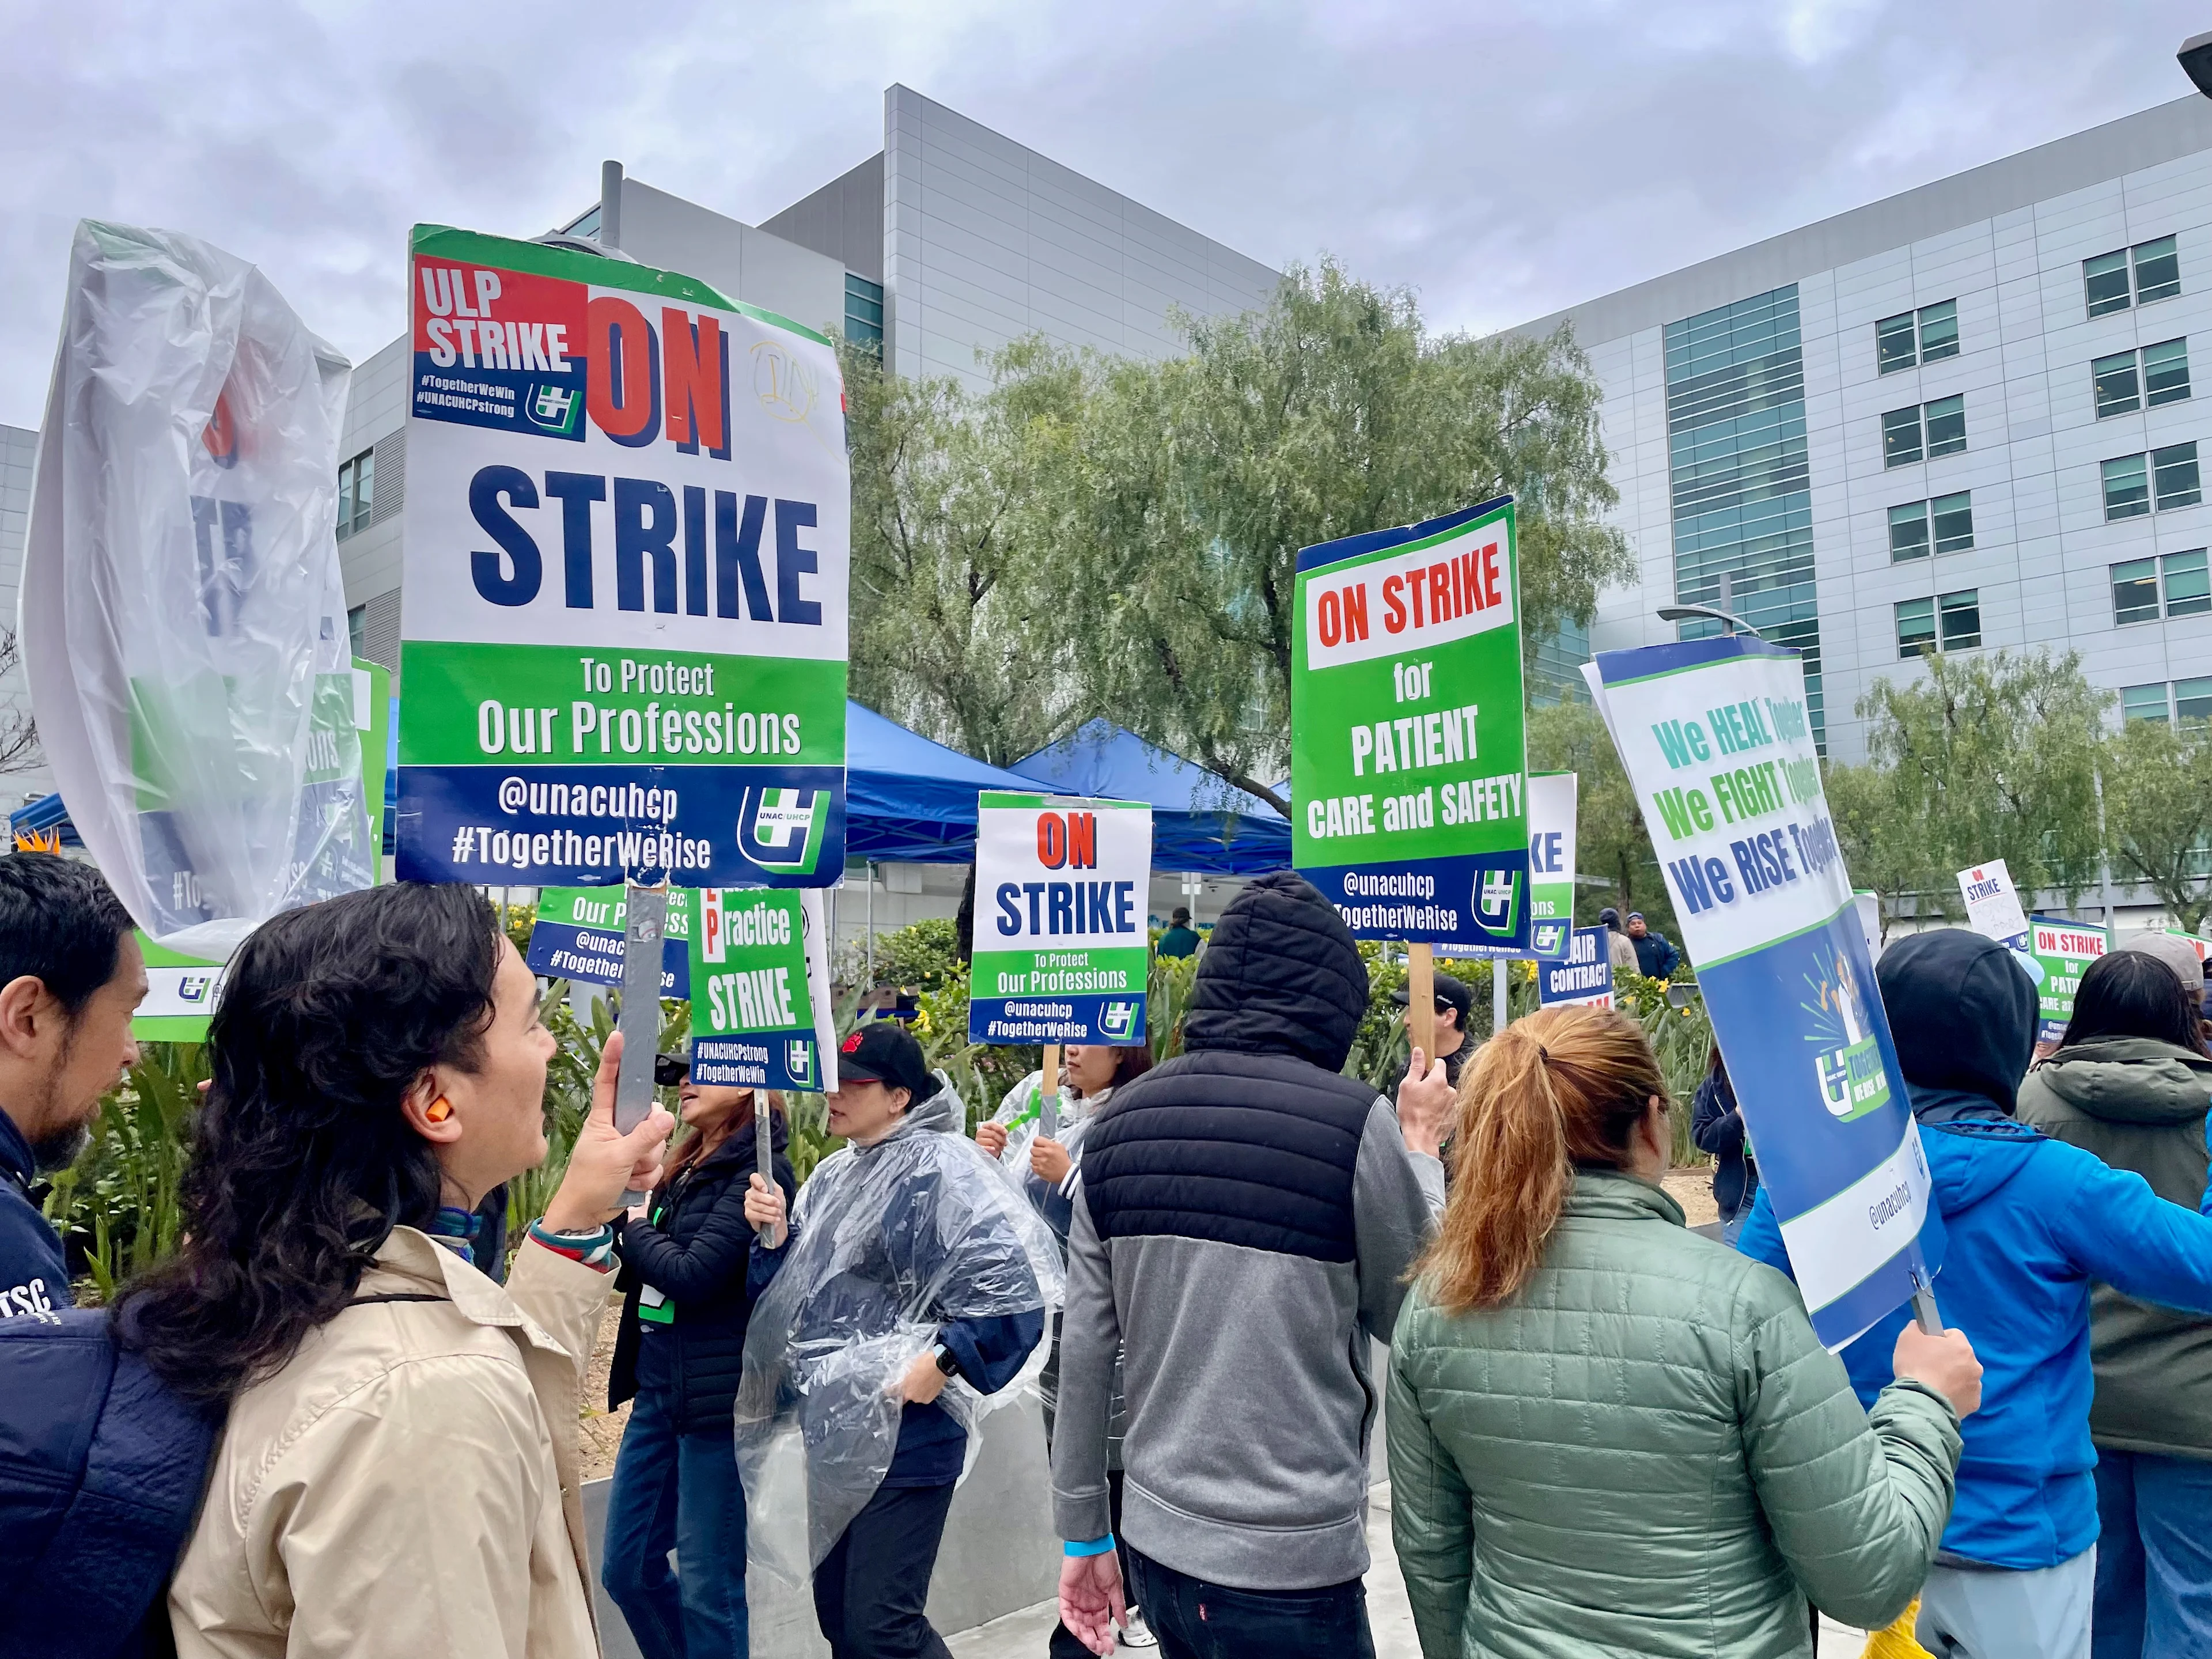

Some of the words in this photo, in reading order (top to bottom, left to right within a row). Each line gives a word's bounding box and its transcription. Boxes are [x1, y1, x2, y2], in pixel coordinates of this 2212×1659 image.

[421, 267, 502, 318] ULP
[426, 318, 572, 373] STRIKE
[421, 374, 515, 400] #TogetherWeWin
[586, 296, 732, 461] ON
[416, 392, 515, 418] #UNACUHCPstrong
[469, 465, 823, 626] STRIKE
[1318, 582, 1369, 647] ON
[1382, 541, 1502, 634] STRIKE
[581, 658, 612, 694] To
[621, 659, 715, 697] Protect
[1393, 661, 1433, 703] for
[478, 699, 558, 754] Our
[572, 701, 802, 755] Professions
[1351, 704, 1478, 777] PATIENT
[1651, 719, 1711, 770] We
[1706, 698, 1773, 756] HEAL
[498, 776, 677, 824] @unacuhcp
[760, 812, 810, 821] UNAC/UHCP
[1307, 794, 1376, 839] CARE
[1383, 786, 1434, 832] and
[1440, 772, 1522, 826] SAFETY
[1652, 786, 1714, 841] We
[1710, 760, 1785, 824] FIGHT
[452, 826, 711, 869] #TogetherWeRise
[1037, 812, 1097, 870] ON
[1667, 854, 1735, 915] We
[1729, 828, 1797, 896] RISE
[1787, 813, 1837, 874] Together
[1972, 869, 1984, 882] ON
[1343, 872, 1435, 900] @unacuhcp
[1967, 878, 2001, 901] STRIKE
[573, 896, 610, 924] Our
[706, 901, 791, 955] Practice
[996, 881, 1136, 936] STRIKE
[1035, 953, 1046, 968] To
[1050, 952, 1089, 968] Protect
[1564, 934, 1596, 965] AIR
[2039, 931, 2056, 950] ON
[2060, 933, 2104, 956] STRIKE
[998, 972, 1026, 994] Our
[1031, 967, 1127, 992] Professions
[1550, 962, 1607, 994] CONTRACT
[2065, 960, 2078, 974] for
[708, 967, 797, 1031] STRIKE
[1005, 1001, 1073, 1021] @unacuhcp
[987, 1021, 1088, 1038] #TogetherWeRise
[696, 1063, 766, 1084] #TogetherWeWin
[697, 1041, 769, 1065] #UNACUHCPstrong
[1869, 1180, 1912, 1230] @unacuhcp
